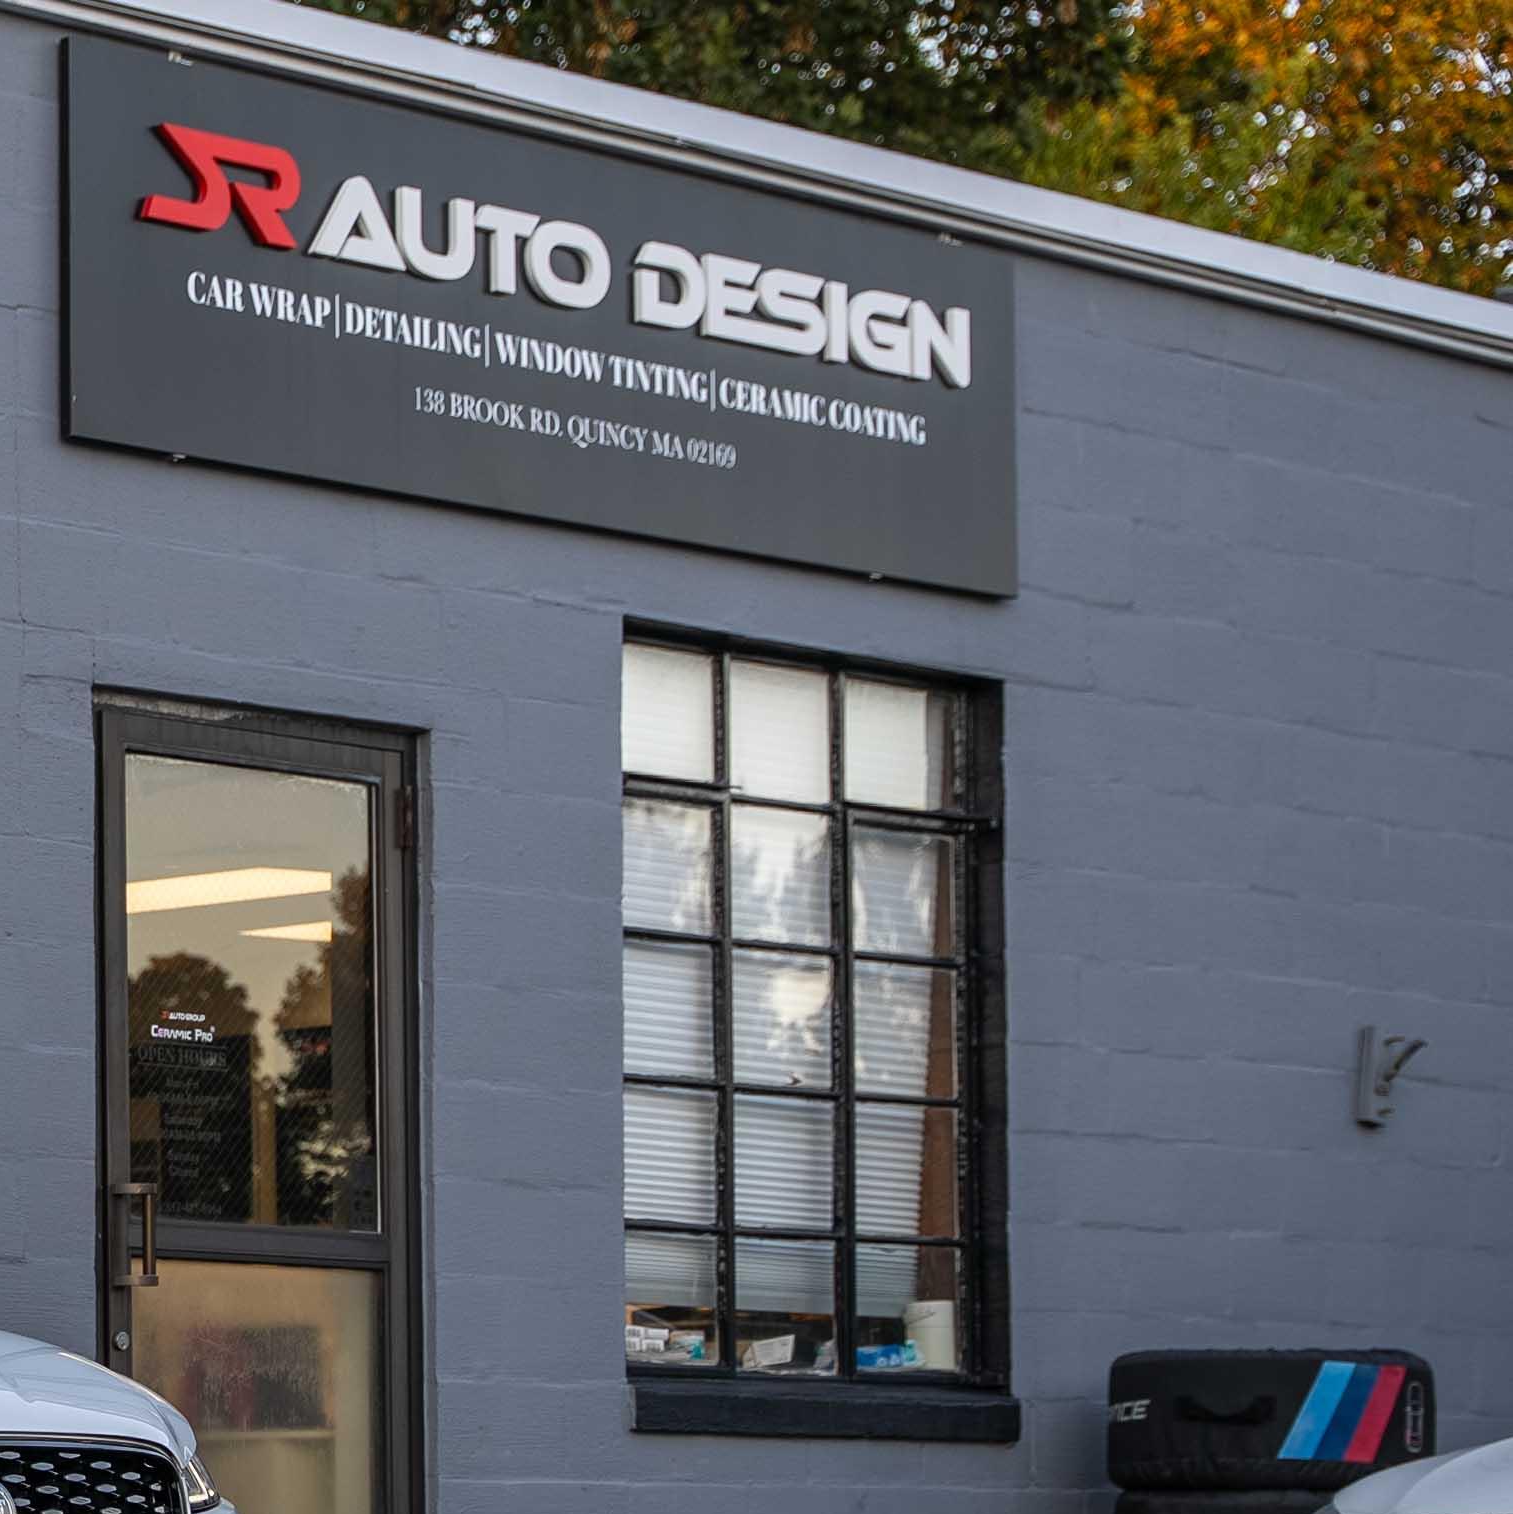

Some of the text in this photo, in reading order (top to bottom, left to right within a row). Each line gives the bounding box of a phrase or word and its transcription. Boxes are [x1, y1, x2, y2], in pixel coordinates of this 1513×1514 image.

[186, 270, 928, 446] CAR WRAP DETAILING WINDOW TINTING CERAMIC COATING
[307, 175, 612, 310] AUTO
[633, 240, 972, 390] DESIGN
[414, 386, 739, 470] 138 BROOK RD. QUINCY MA 02169
